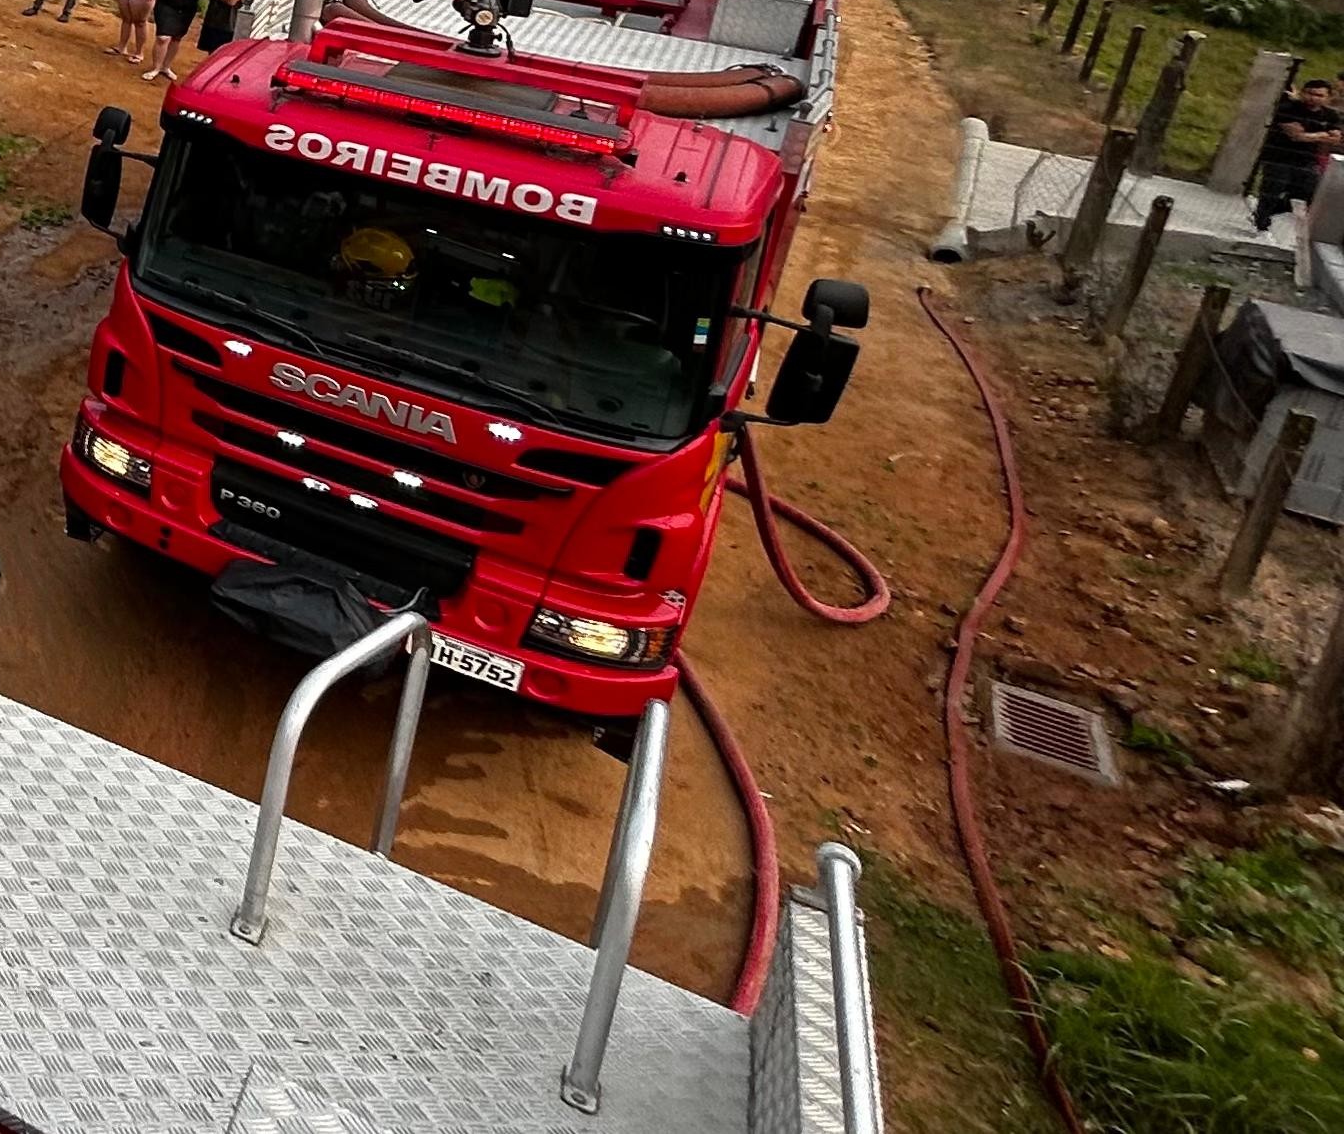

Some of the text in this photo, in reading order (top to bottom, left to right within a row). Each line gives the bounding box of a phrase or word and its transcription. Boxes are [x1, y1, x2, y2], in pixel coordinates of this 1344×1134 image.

[269, 362, 457, 444] SCANIA
[220, 488, 281, 519] P 360
[430, 644, 516, 688] H-5752
